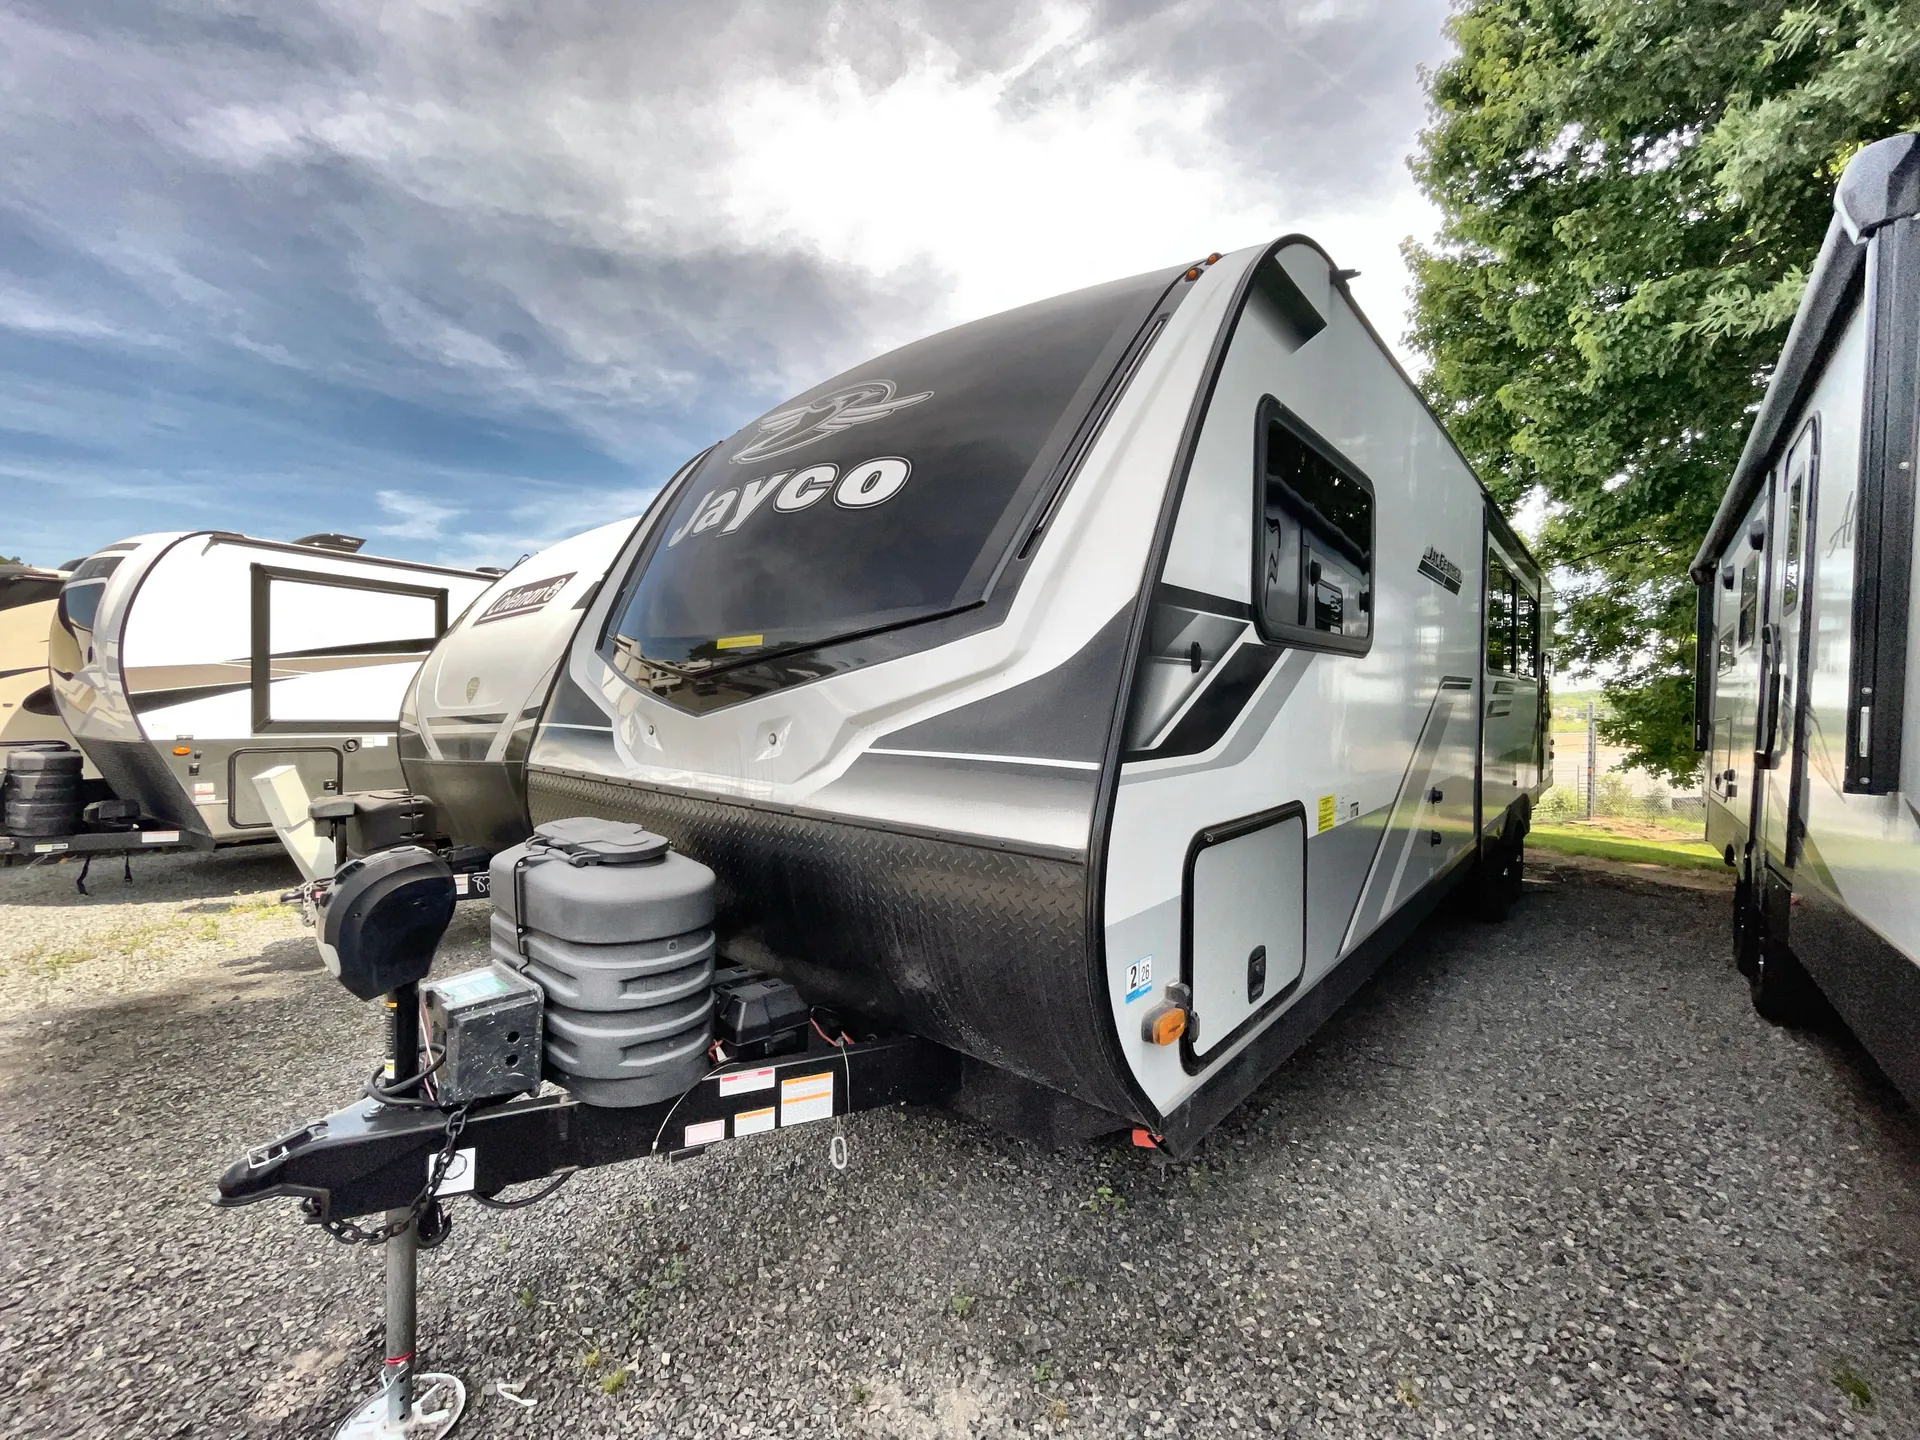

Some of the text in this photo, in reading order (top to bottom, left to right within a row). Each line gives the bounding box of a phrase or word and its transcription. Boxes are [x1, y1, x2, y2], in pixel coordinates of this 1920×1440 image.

[667, 456, 912, 550] Jayco
[487, 587, 551, 615] Coleman
[1130, 963, 1150, 990] 2 26
